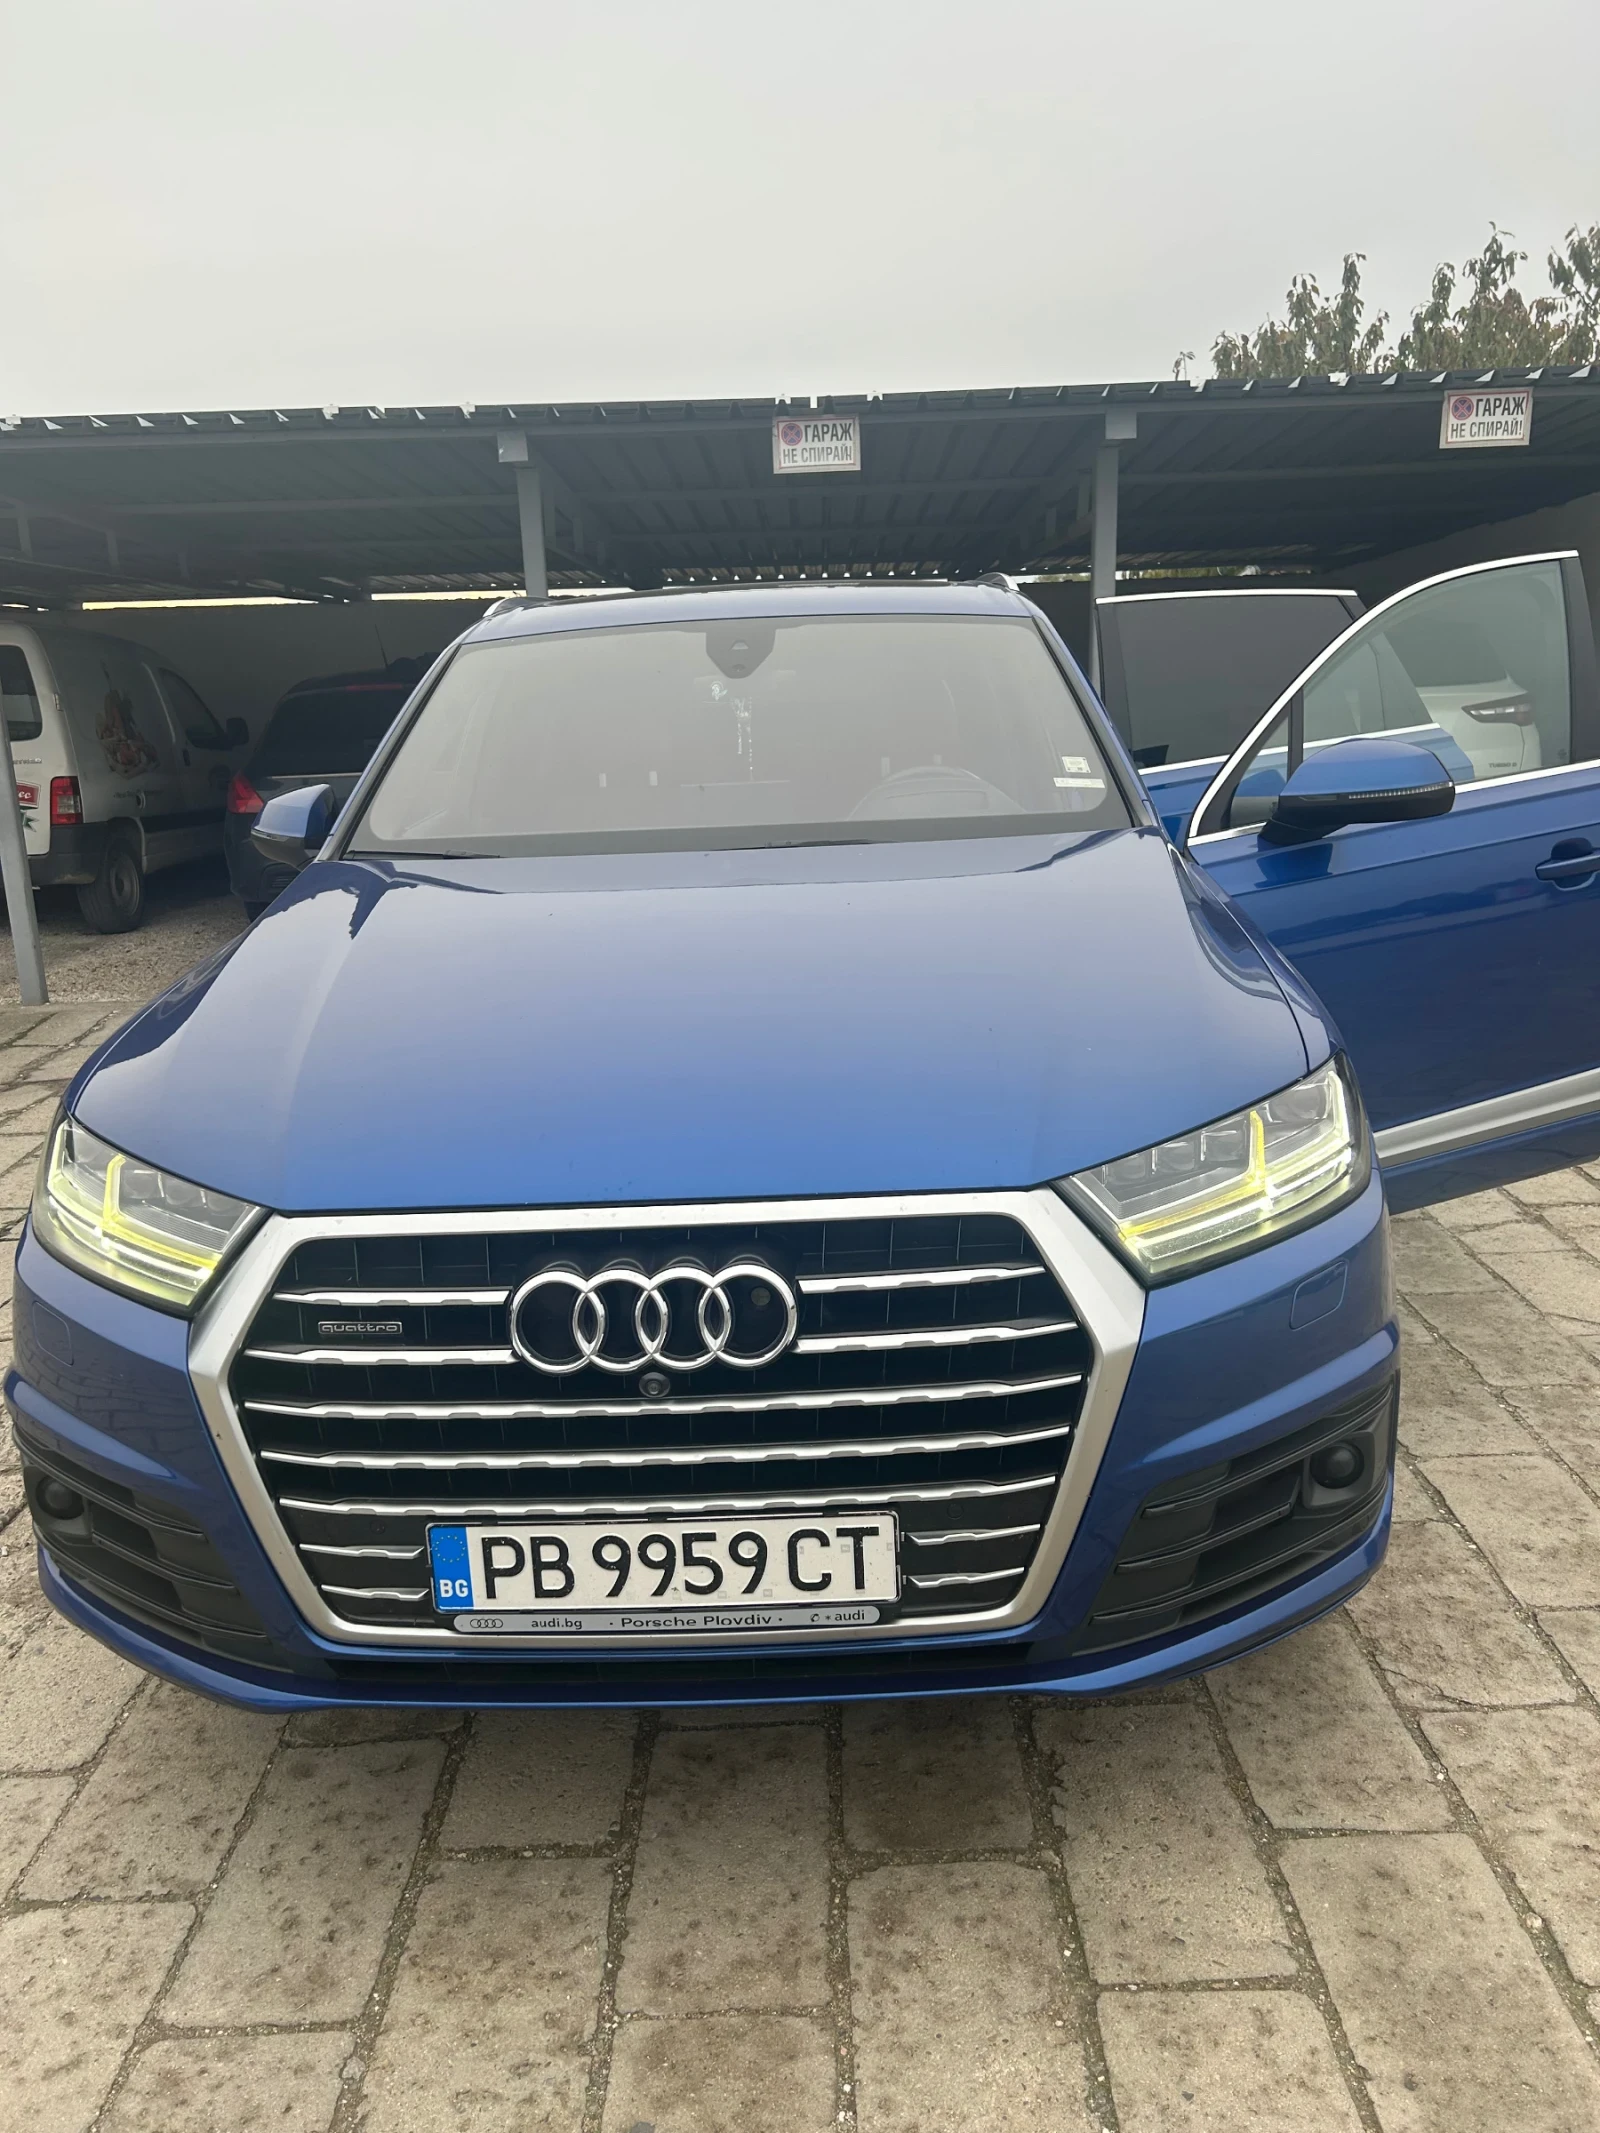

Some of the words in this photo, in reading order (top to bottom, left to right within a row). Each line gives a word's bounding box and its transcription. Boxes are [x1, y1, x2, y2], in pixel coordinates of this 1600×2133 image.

[1475, 396, 1526, 417] ГАРАЖ
[804, 422, 852, 442] ГАРАЖ
[1450, 422, 1466, 439] НЕ
[1469, 417, 1523, 438] СПИРАЙ!
[782, 448, 798, 464] НЕ
[321, 1323, 398, 1333] quattro
[481, 1536, 575, 1599] PB
[591, 1530, 768, 1598] 9959
[787, 1525, 880, 1592] CT
[439, 1578, 469, 1598] BG
[531, 1618, 583, 1630] audi.bg
[621, 1616, 697, 1628] Porsche
[703, 1614, 772, 1626] Plovdiv
